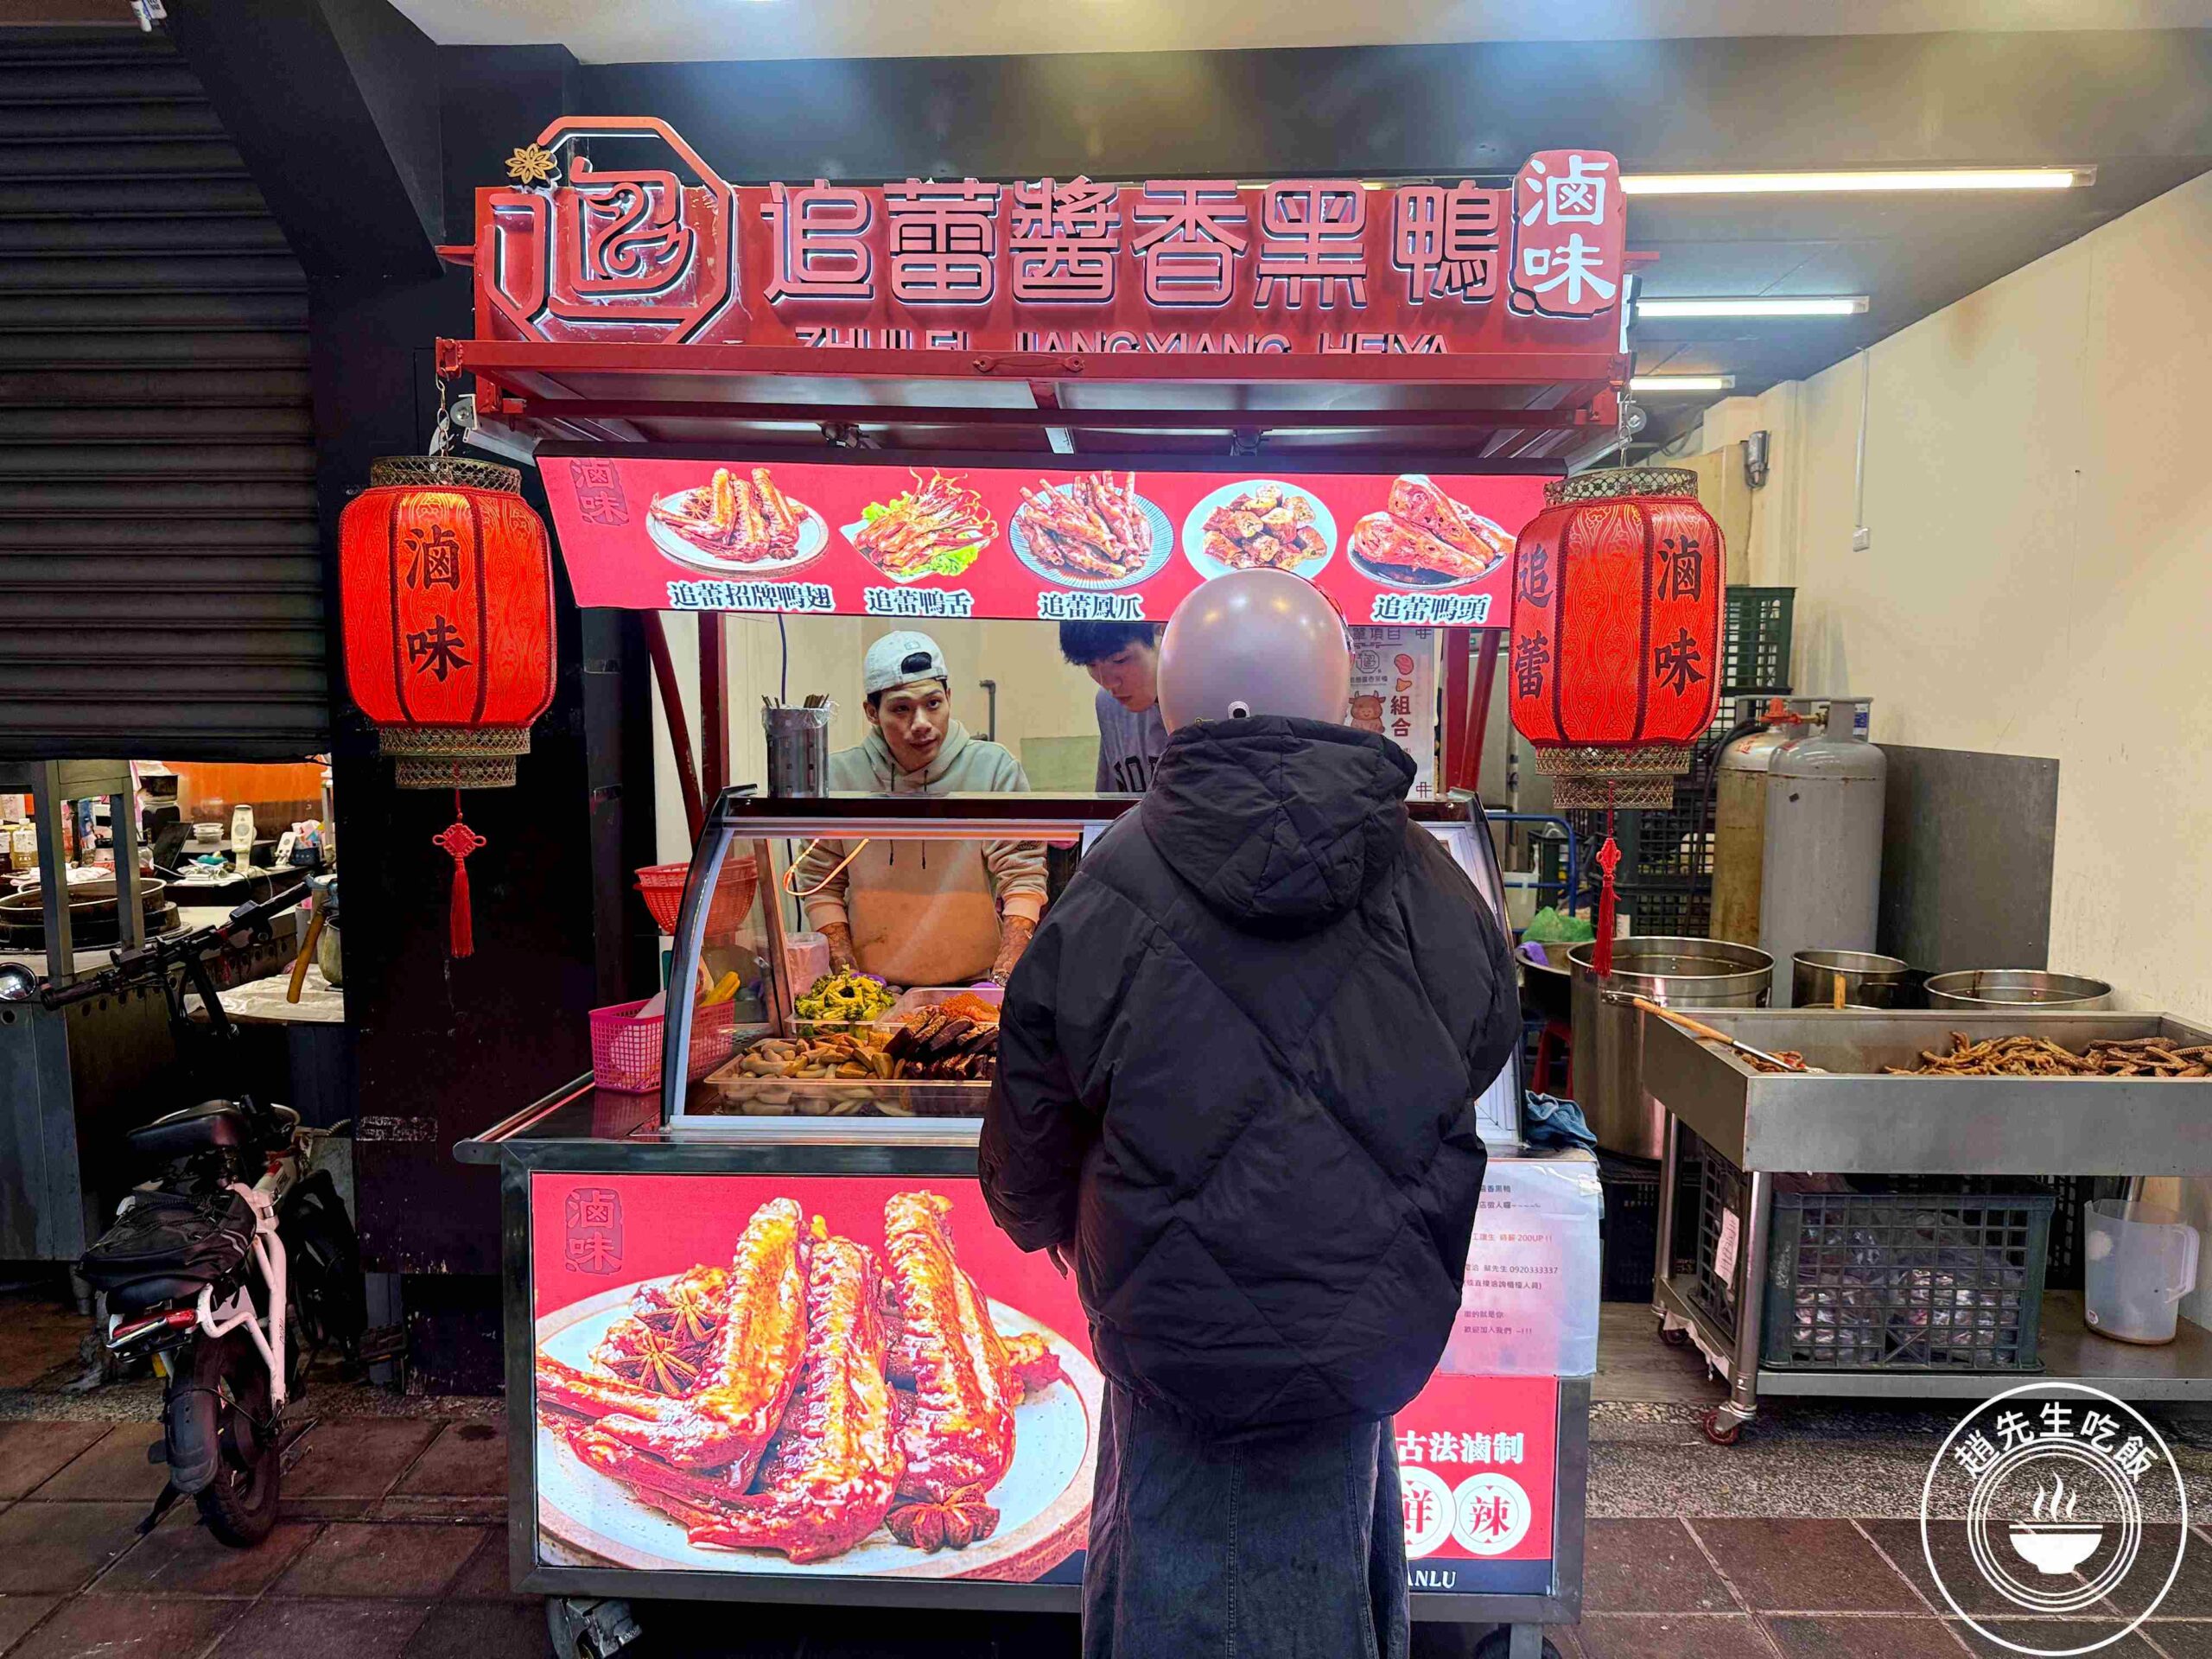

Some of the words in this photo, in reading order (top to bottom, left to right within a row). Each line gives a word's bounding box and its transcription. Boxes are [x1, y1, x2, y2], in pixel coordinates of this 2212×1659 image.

[760, 175, 1499, 307] 追蕾醬香黑鴨
[1521, 154, 1617, 305] 滷味
[404, 524, 474, 683] 滷味
[669, 582, 834, 610] 追蕾招牌鴨翅
[866, 589, 972, 615] 追蕾鴨舌
[1039, 593, 1143, 620] 追蕾鳳爪
[1373, 594, 1490, 621] 追蕾鴨頭
[1515, 543, 1554, 701] 追蕾
[1656, 536, 1706, 697] 滷味
[1390, 695, 1411, 737] 組合
[568, 1190, 623, 1271] 滷味
[1470, 1496, 1512, 1536] 辣
